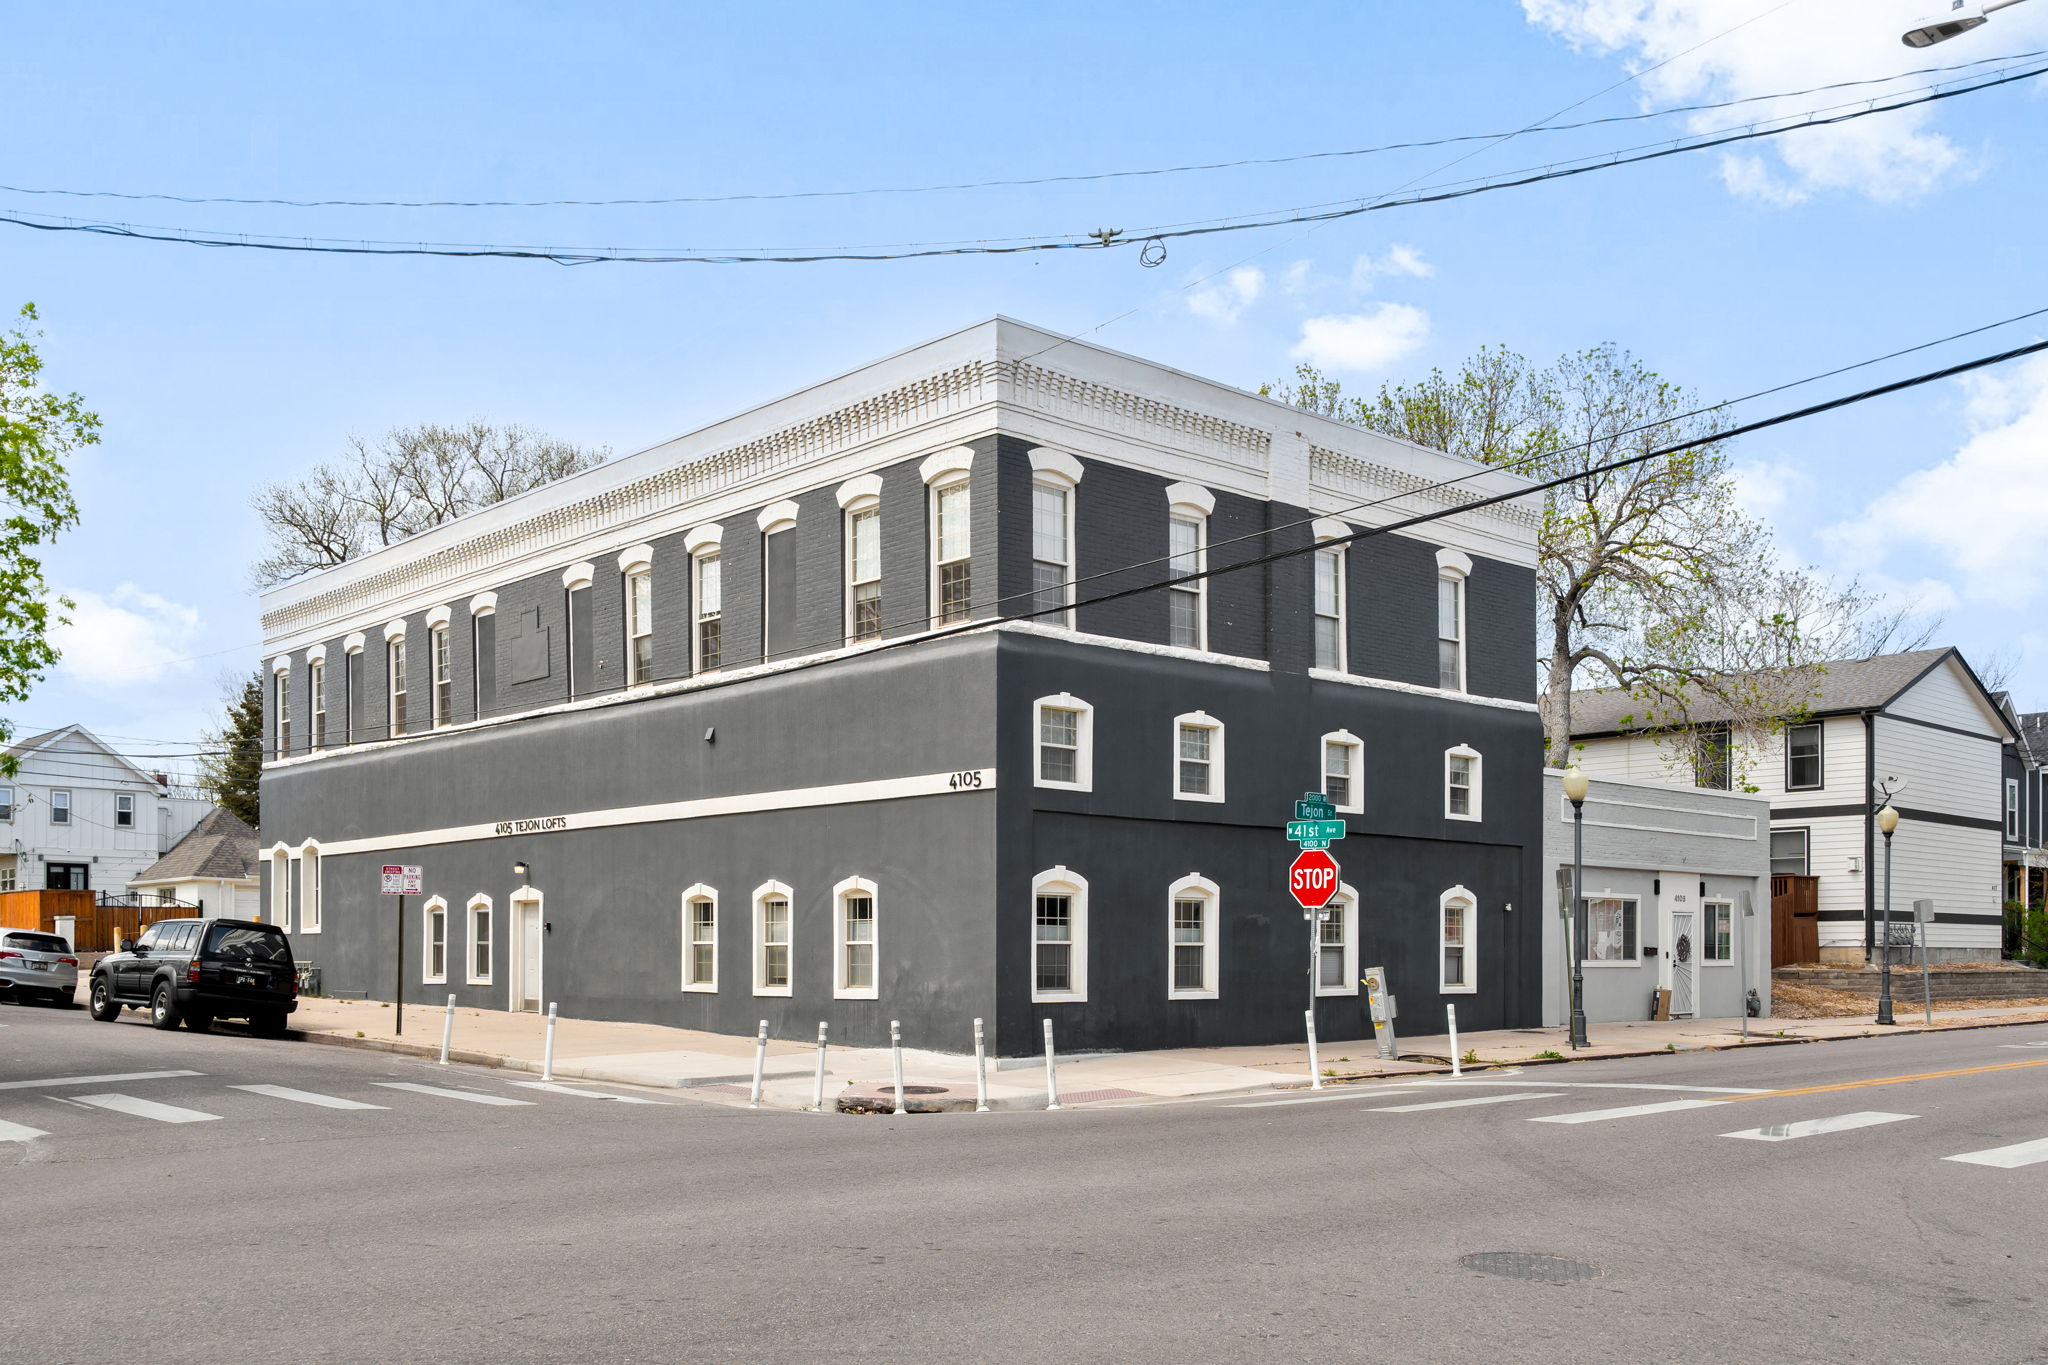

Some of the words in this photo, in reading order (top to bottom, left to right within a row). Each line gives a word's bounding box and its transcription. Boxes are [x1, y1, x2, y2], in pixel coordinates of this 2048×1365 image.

[949, 771, 982, 790] 4105
[1308, 794, 1321, 802] 2000
[1301, 803, 1324, 819] Tejon
[495, 822, 513, 835] 4105
[515, 819, 540, 832] TEJON
[541, 816, 567, 830] LOFTS
[1288, 827, 1293, 835] W
[1294, 824, 1319, 837] 41st
[1325, 826, 1336, 834] Ave
[1321, 839, 1327, 847] N
[1293, 868, 1334, 890] STOP
